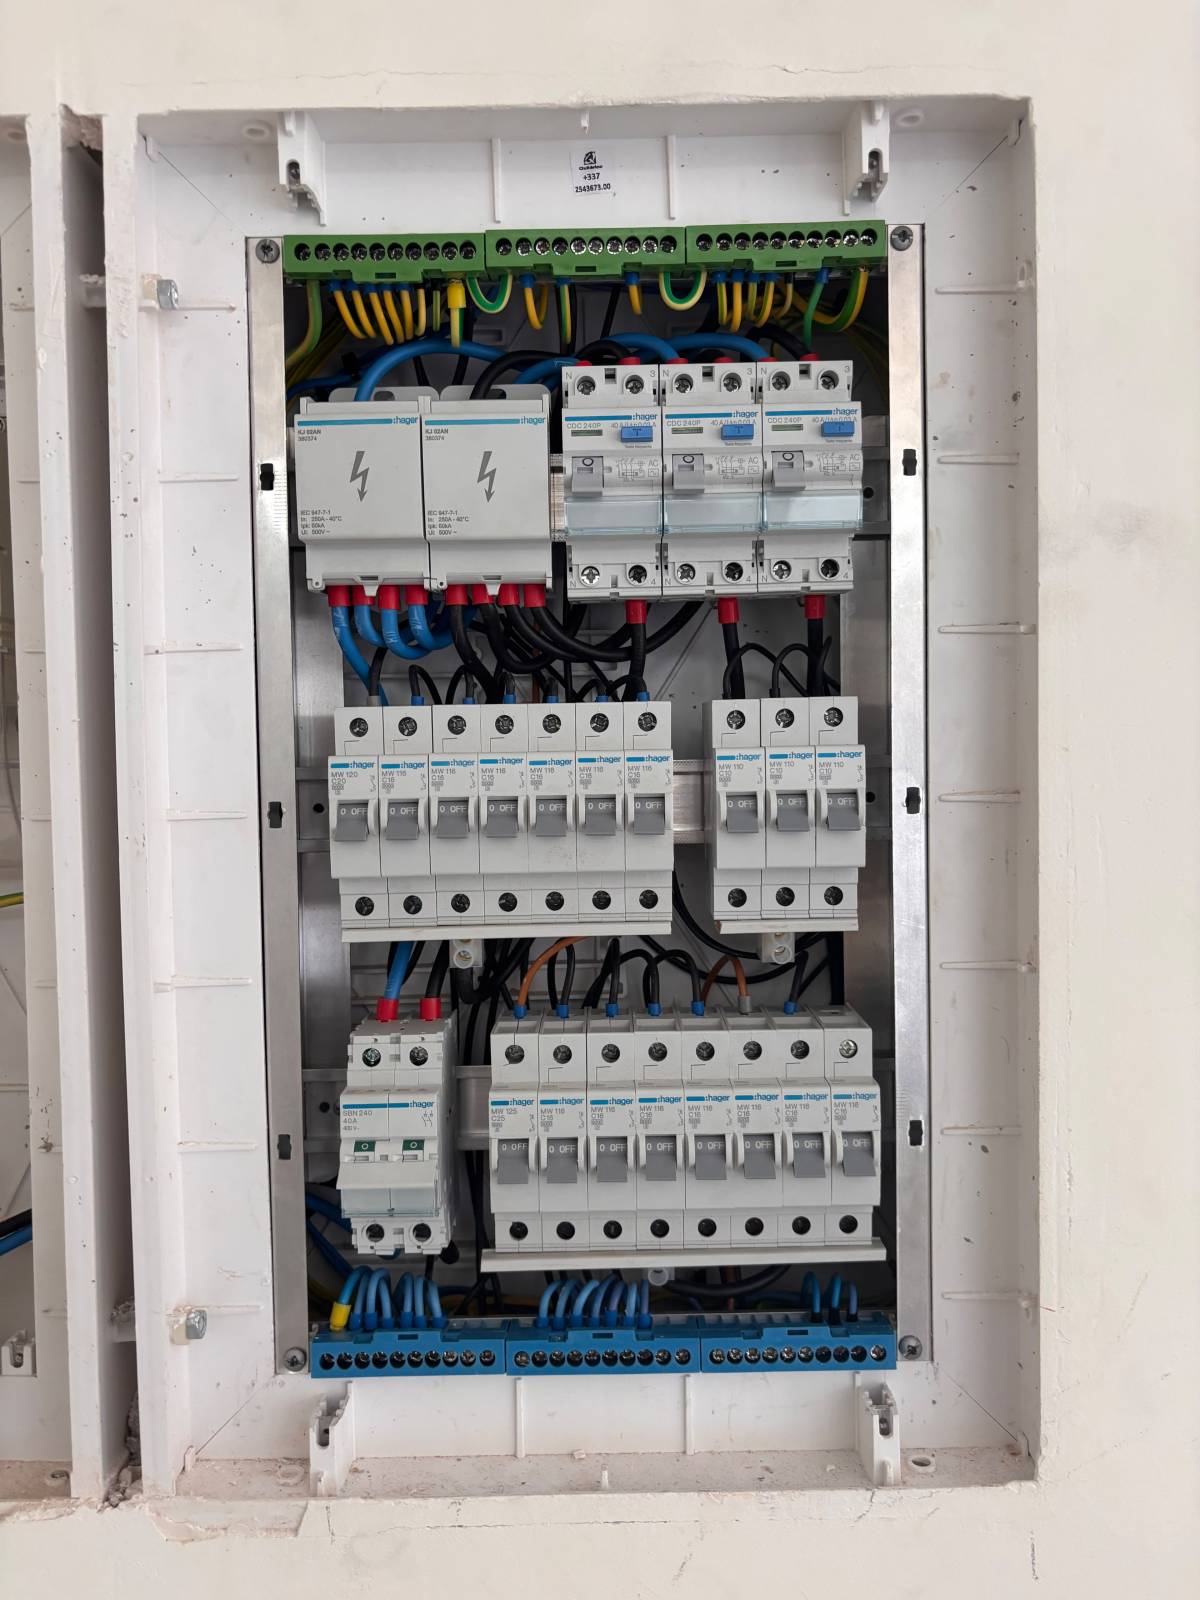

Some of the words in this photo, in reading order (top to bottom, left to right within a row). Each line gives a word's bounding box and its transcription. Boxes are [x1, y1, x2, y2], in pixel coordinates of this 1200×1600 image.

[583, 173, 600, 181] +337
[646, 801, 664, 809] OFF
[738, 800, 753, 808] OFF
[788, 798, 805, 806] OFF
[837, 797, 855, 805] OFF
[450, 805, 467, 813] OFF
[499, 804, 516, 812] OFF
[549, 803, 566, 811] OFF
[598, 802, 615, 810] OFF
[400, 807, 417, 815] OFF
[511, 1143, 528, 1151] OFF
[609, 1143, 627, 1152] OFF
[657, 1143, 673, 1151] OFF
[707, 1141, 725, 1149] OFF
[755, 1140, 773, 1149] OFF
[804, 1140, 820, 1148] OFF
[559, 1145, 576, 1153] OFF
